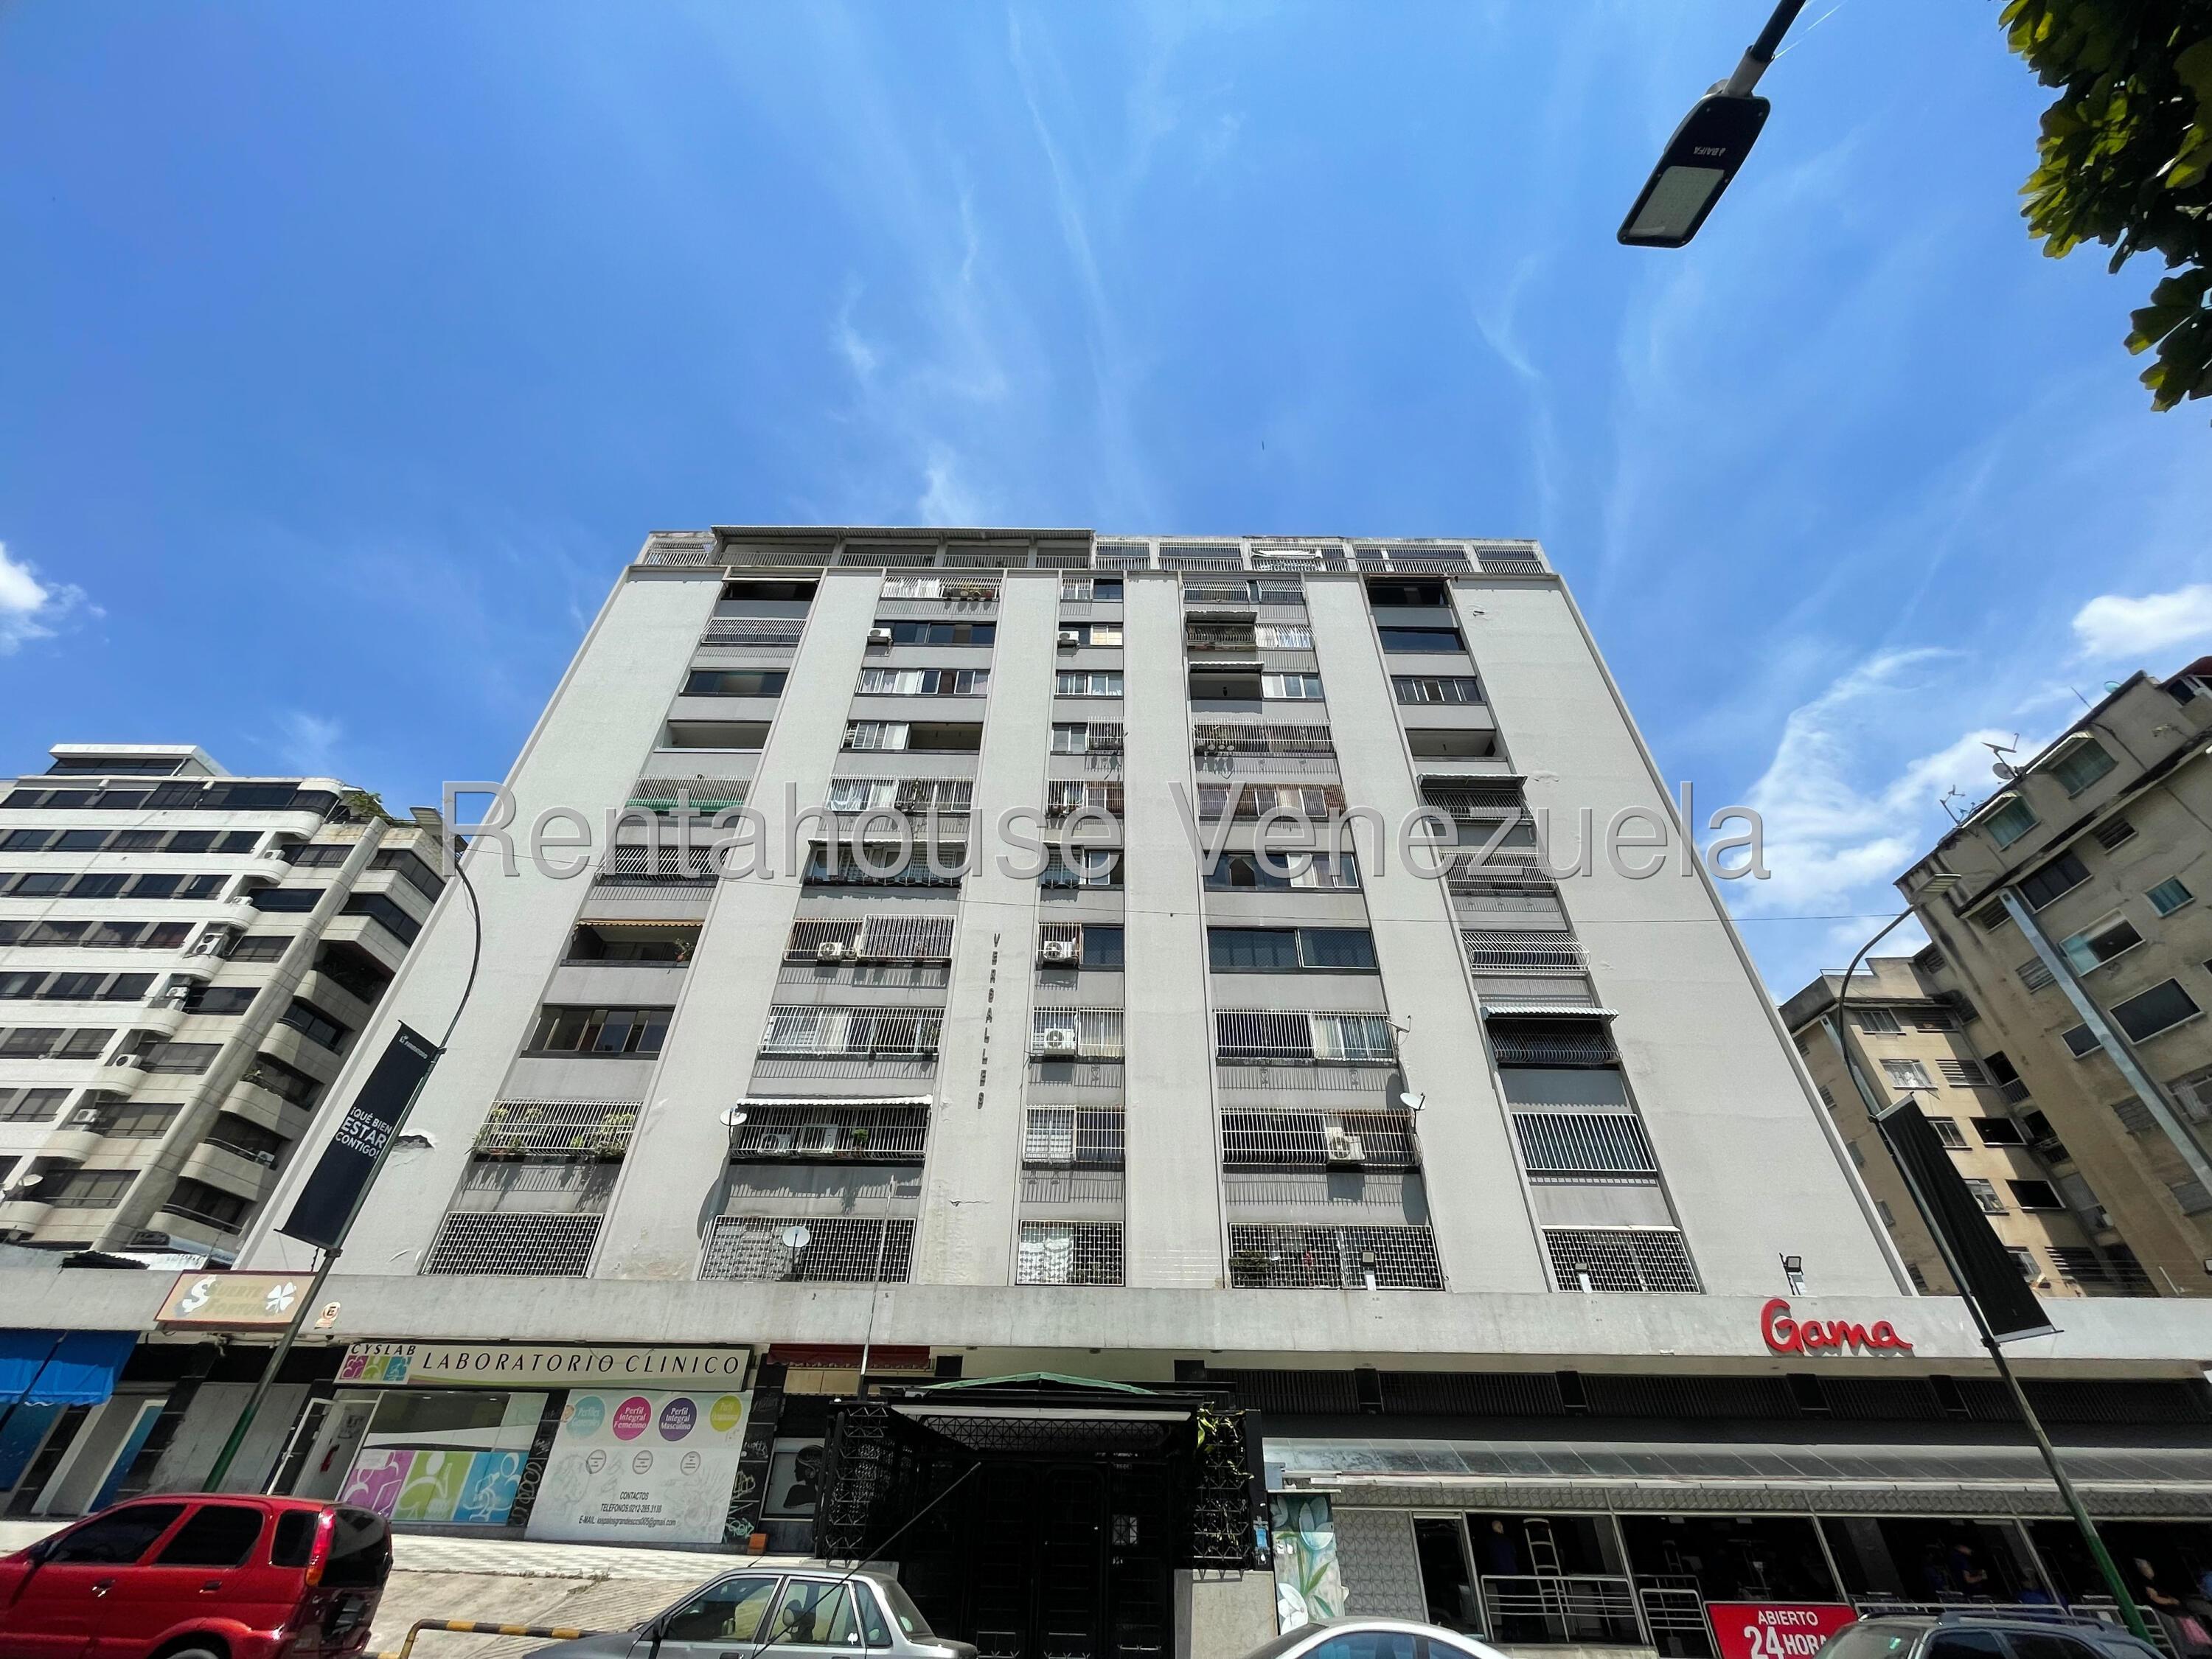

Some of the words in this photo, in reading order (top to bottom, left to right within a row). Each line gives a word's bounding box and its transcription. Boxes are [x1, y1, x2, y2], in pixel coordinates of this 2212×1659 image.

[978, 933, 1001, 1109] VERSALLES
[350, 1107, 374, 1124] ¡QUÉ
[372, 1118, 393, 1134] BIEN
[341, 1116, 386, 1149] ESTAR
[335, 1131, 380, 1159] CONTIGO!
[1761, 1298, 1914, 1354] Gama
[351, 1344, 416, 1355] CYSLAB
[422, 1352, 613, 1372] LABORATORIO
[626, 1355, 738, 1374] CLINICO
[619, 1413, 647, 1422] Integral
[625, 1406, 644, 1414] Perfil
[666, 1414, 690, 1423] Integral
[661, 1422, 691, 1430] Masculino
[620, 1492, 649, 1500] CONTACTOS
[1759, 1610, 1818, 1626] ABIERTO
[1744, 1626, 1784, 1659] 24
